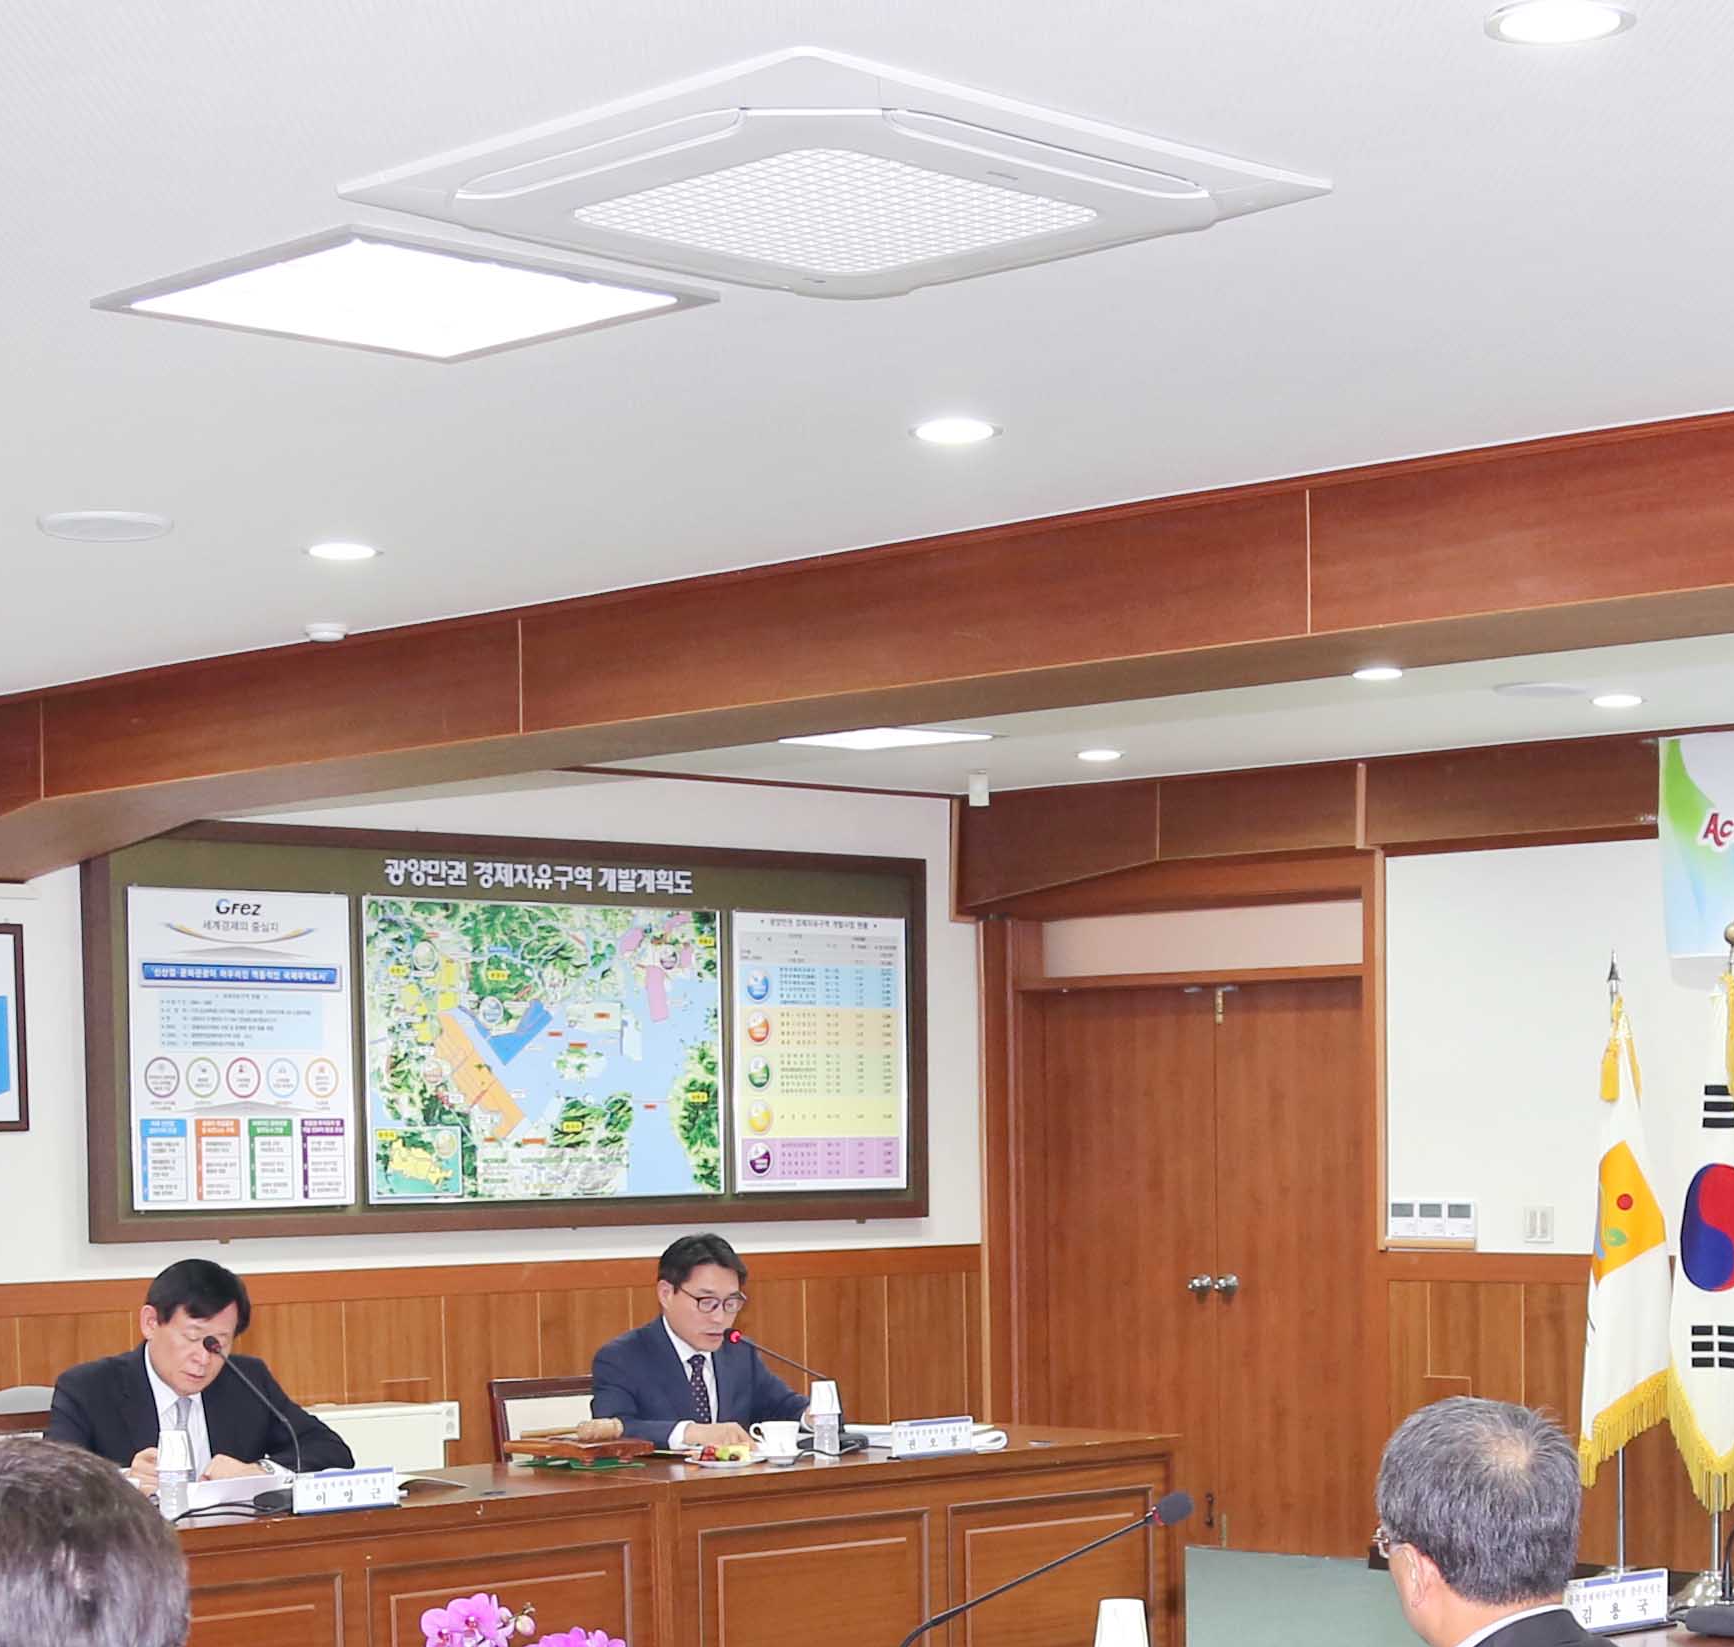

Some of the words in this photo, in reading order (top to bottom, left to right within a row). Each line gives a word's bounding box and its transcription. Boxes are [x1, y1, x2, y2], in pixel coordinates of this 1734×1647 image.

[384, 858, 467, 887] 광양만권
[473, 861, 594, 892] 경제자유구역
[598, 866, 693, 895] 개발계획도
[202, 919, 250, 932] 세계경제의
[251, 920, 280, 933] 중심지
